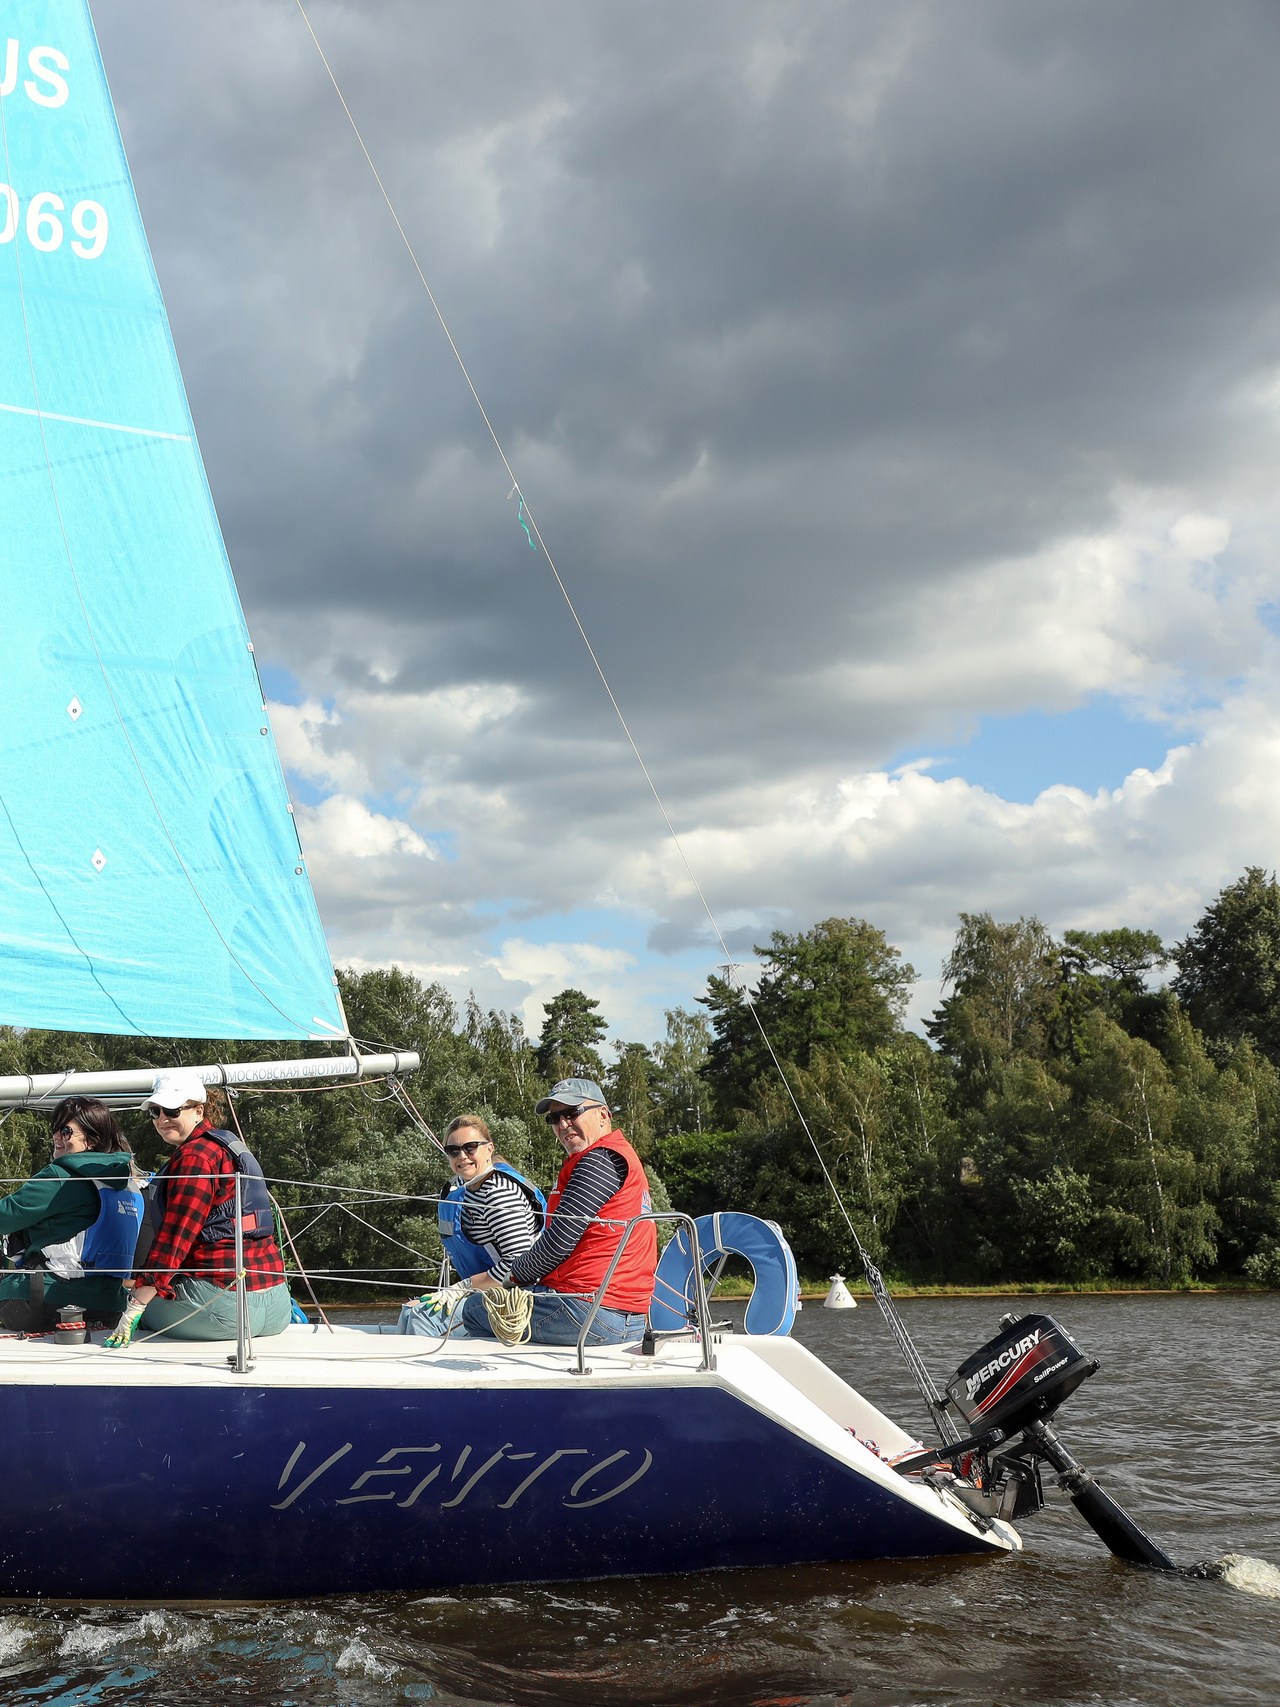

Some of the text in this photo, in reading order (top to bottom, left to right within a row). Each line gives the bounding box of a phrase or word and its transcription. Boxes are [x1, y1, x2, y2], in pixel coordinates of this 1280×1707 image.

[228, 1065, 300, 1082] МОСКОВСКАЯ
[302, 1061, 357, 1076] ФЛОТИЛИЯ
[965, 1328, 1041, 1400] MERCURY
[1034, 1357, 1068, 1383] SailPower
[270, 1441, 653, 1510] VENTO
